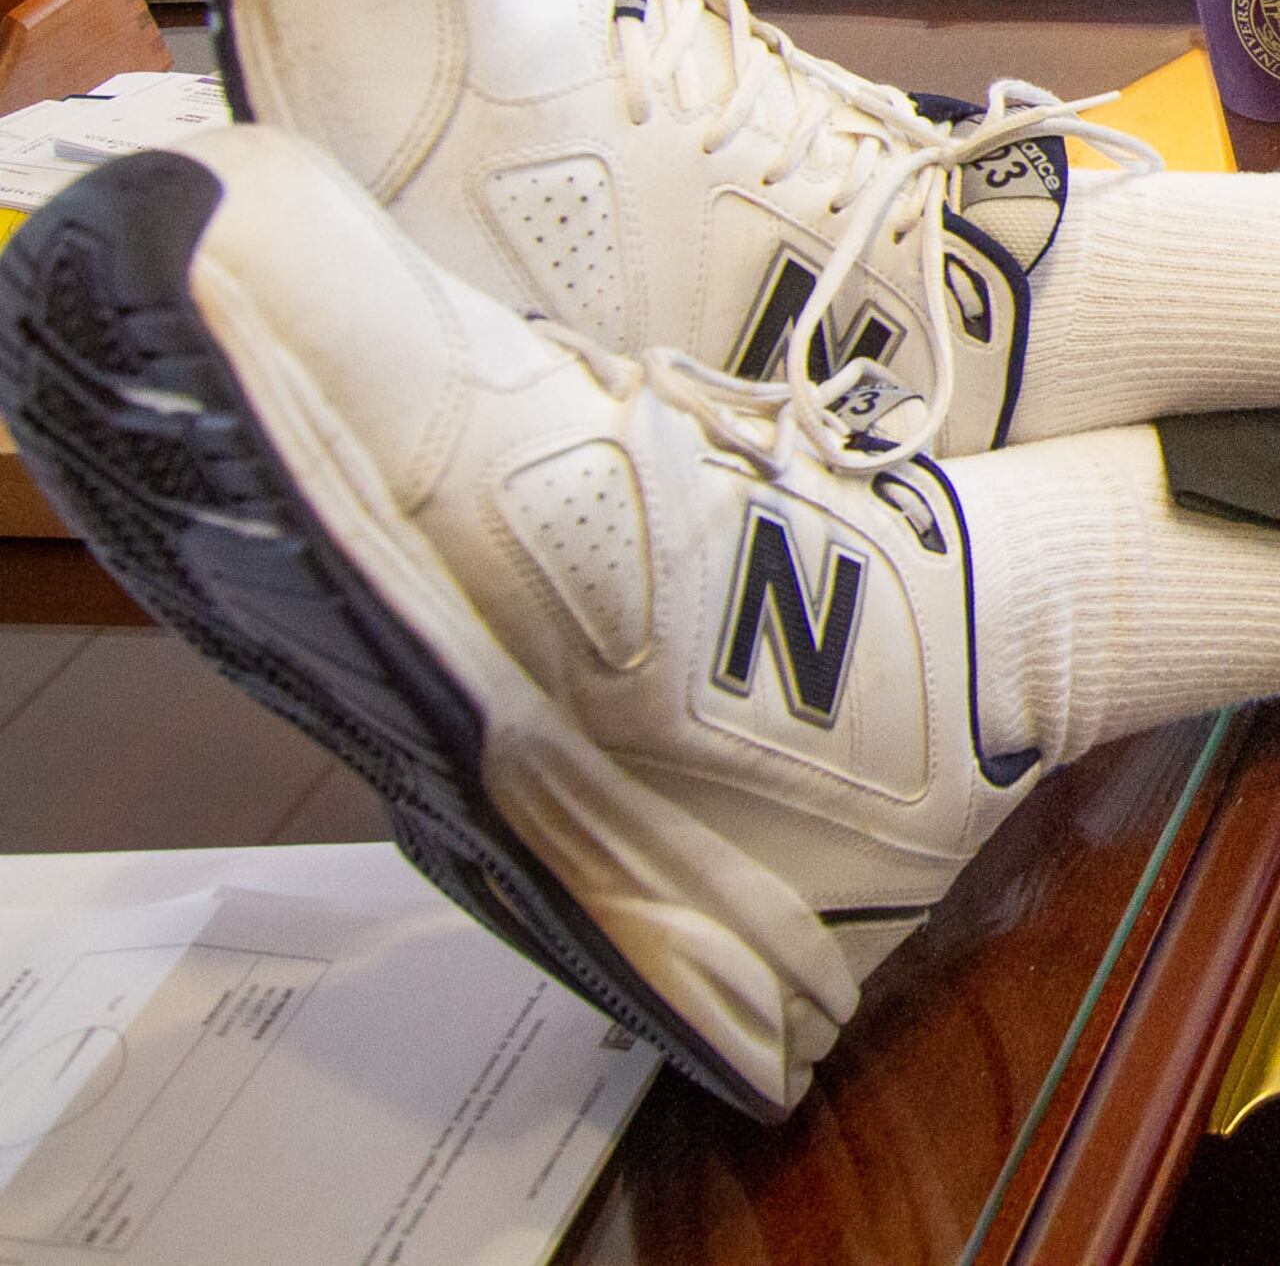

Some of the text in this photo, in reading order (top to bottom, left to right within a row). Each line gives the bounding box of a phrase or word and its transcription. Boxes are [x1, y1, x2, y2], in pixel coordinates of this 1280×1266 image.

[970, 144, 1028, 189] 23
[1021, 142, 1061, 191] ance
[724, 243, 902, 382] N
[714, 503, 868, 728] N
